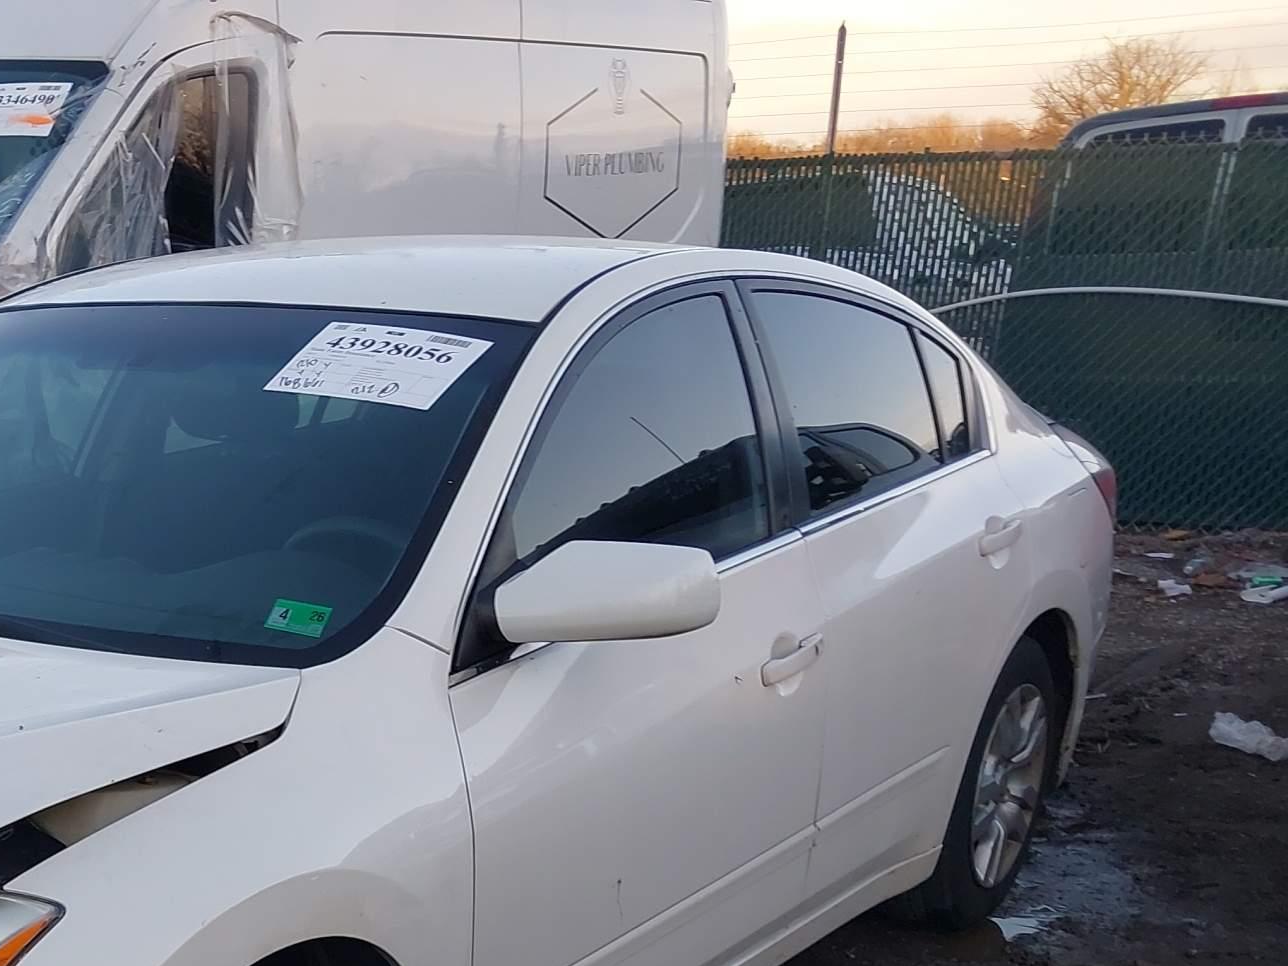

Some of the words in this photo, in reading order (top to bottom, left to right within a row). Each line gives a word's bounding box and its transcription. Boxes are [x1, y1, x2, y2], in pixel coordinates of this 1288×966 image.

[565, 153, 600, 177] VIPER
[603, 151, 665, 176] PLUMBING
[326, 336, 459, 363] 43928056
[279, 608, 290, 621] 4
[309, 610, 327, 623] 26
